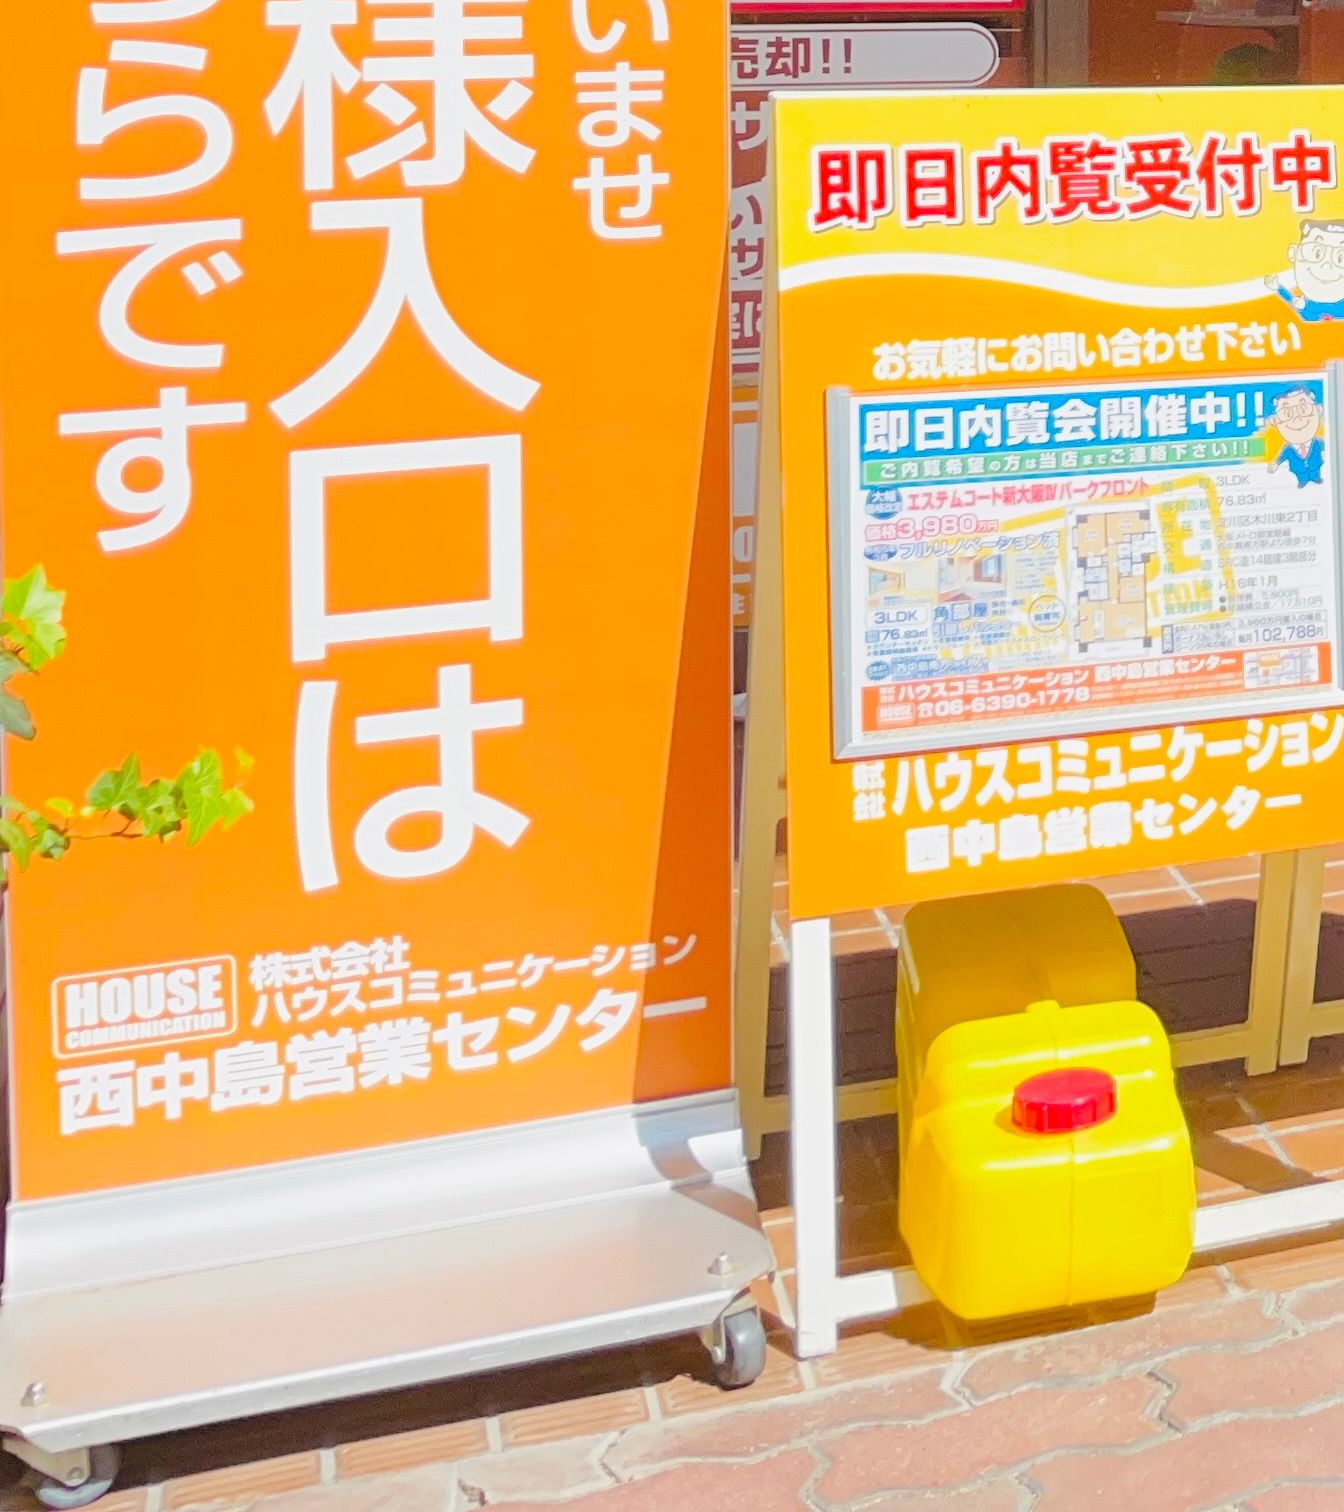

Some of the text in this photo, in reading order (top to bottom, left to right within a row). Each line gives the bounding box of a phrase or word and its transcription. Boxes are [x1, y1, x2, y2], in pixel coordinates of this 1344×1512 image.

[812, 132, 1334, 228] 即日内覧受付中
[871, 319, 1302, 382] お気軽にお問い合わせ下さい
[862, 389, 1265, 456] 即日内覧会開催中!!
[62, 963, 225, 1029] HOUSE
[248, 935, 411, 992] 株式会社
[250, 934, 698, 1029] ハウスコミュニケーション
[55, 986, 708, 1137] 西中島営業センター
[64, 1009, 227, 1049] COMMUNICATION
